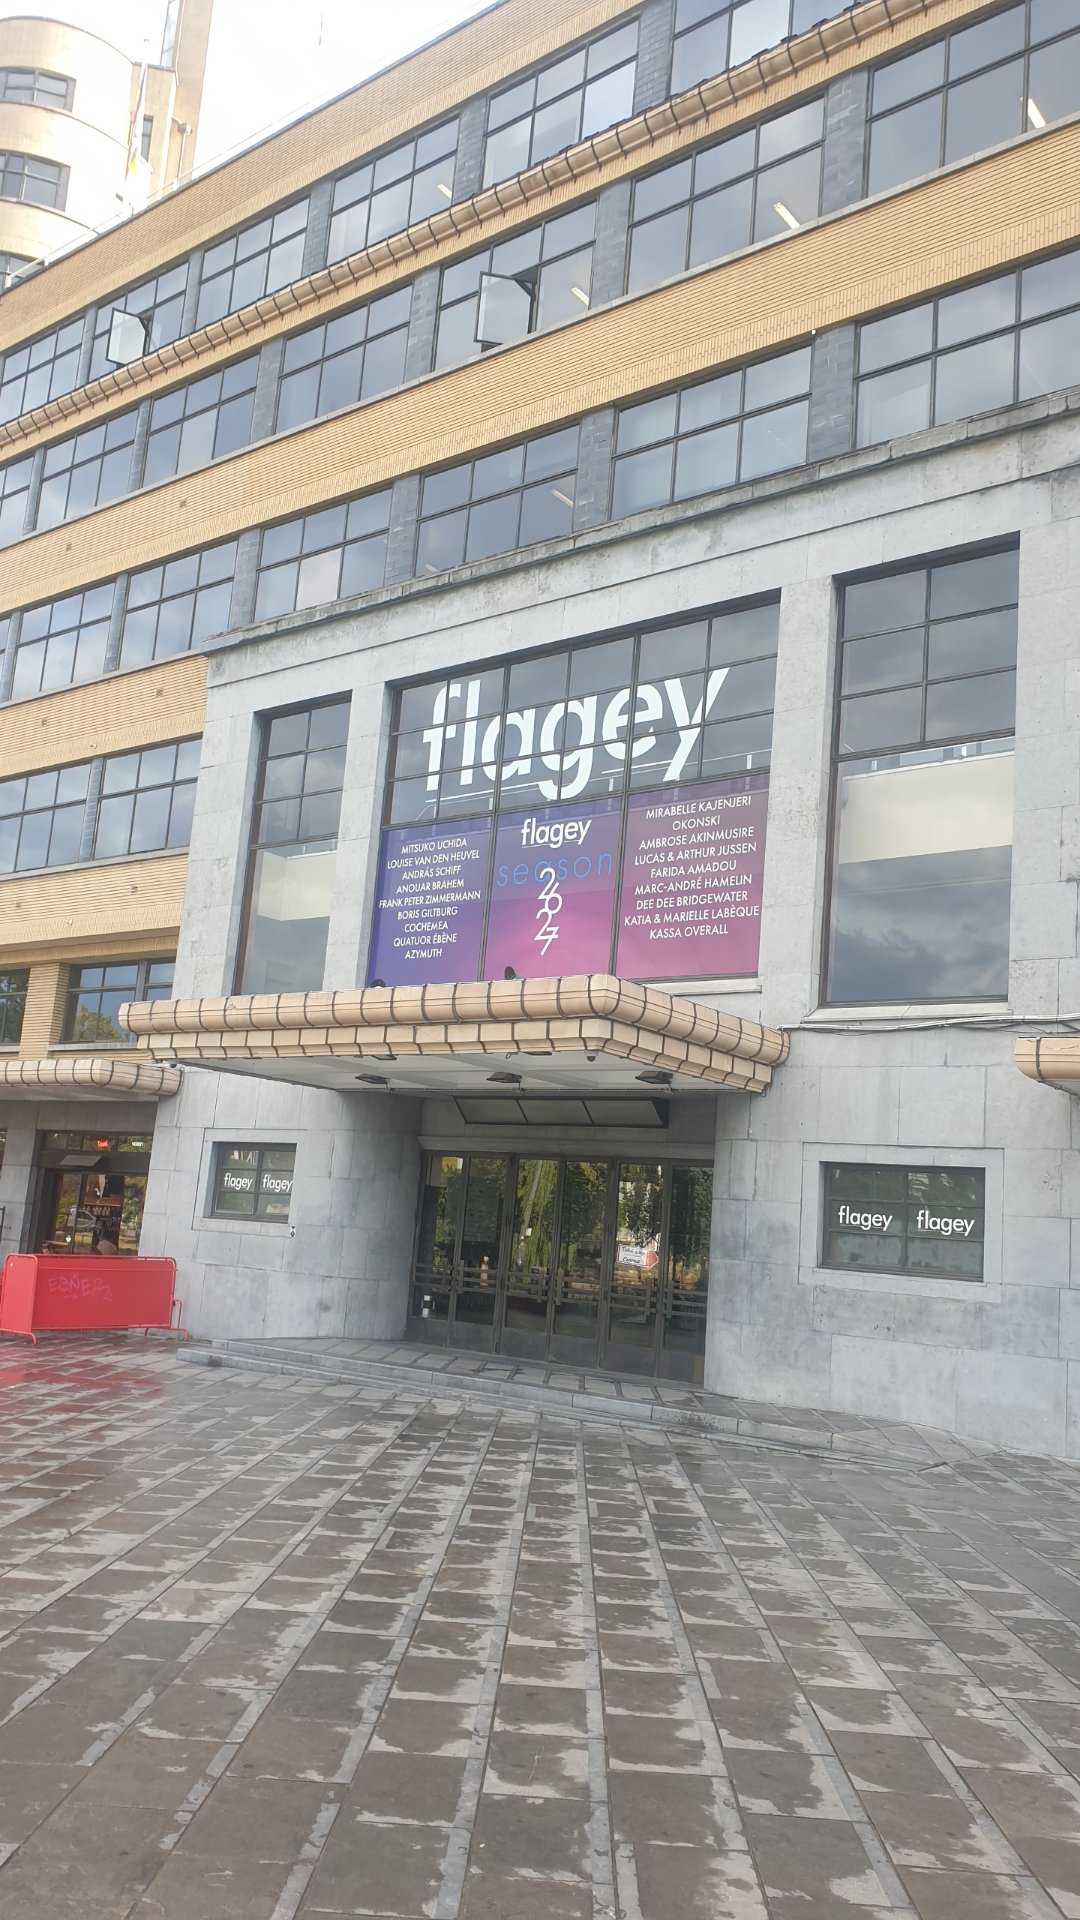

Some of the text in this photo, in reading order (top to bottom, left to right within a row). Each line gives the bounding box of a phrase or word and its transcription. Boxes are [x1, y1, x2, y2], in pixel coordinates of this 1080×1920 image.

[422, 667, 730, 800] flagey
[646, 796, 751, 819] MIRABELLE KAJENJERI
[673, 815, 720, 830] OKONSKI
[521, 818, 592, 849] flagey
[639, 827, 754, 850] AMBROSE AKINMUSIRE
[402, 838, 467, 854] MITSUKO UCHIDA
[635, 842, 757, 865] LUCAS & ARTHUR JUSSEN
[388, 850, 479, 869] LOUISE VAN DEN HEUVEL
[651, 860, 736, 878] FARIDA AMADOU
[402, 866, 461, 880] ANDRÁS SCHIFF
[497, 853, 612, 887] season
[396, 879, 464, 894] ANOUAR BRAHEM
[635, 874, 752, 895] MARC-ANDRÉ HAMELIN
[379, 890, 481, 908] FRANK PETER ZIMMERMANN
[636, 891, 748, 910] DEE DEE BRIDGEWATER
[398, 907, 458, 920] BORIS GILTBURG
[625, 905, 759, 926] KATIA & MARIELLE LABÈQUE
[404, 921, 448, 932] COCHEMEA
[650, 924, 728, 939] KASSA OVERALL
[394, 932, 457, 946] QUATUOR ÉBÈNE
[405, 948, 442, 959] AZYMUTH
[224, 1172, 253, 1191] flagey
[263, 1174, 293, 1193] flagey
[838, 1205, 893, 1231] flagey
[916, 1209, 975, 1237] flagey
